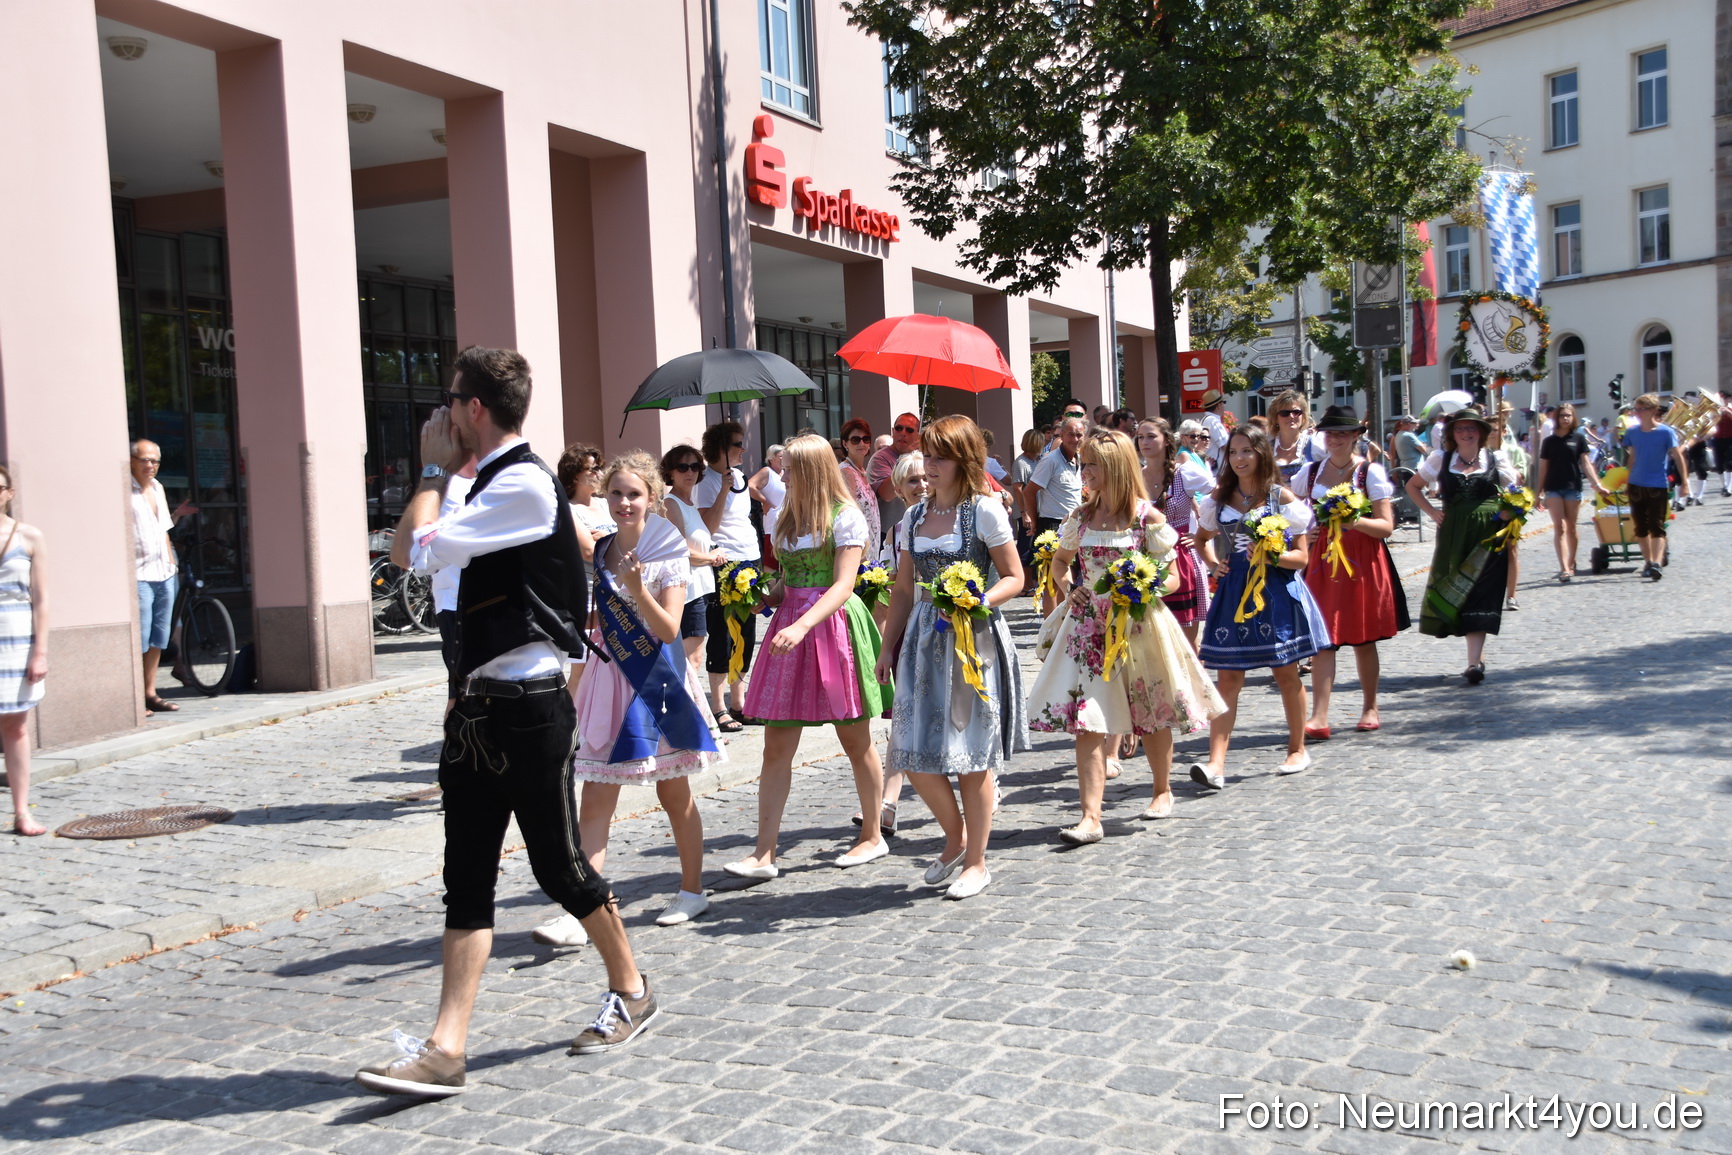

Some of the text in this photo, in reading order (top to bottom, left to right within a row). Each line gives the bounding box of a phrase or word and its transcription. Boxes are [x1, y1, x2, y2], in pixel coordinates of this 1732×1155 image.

[793, 176, 901, 243] Sparkasse
[1366, 291, 1389, 302] ZONE
[1274, 369, 1292, 379] AOK
[1465, 349, 1514, 374] BLASKAPELE
[606, 594, 636, 635] Volksfest
[632, 634, 655, 657] 2015
[606, 629, 632, 662] Dearndl
